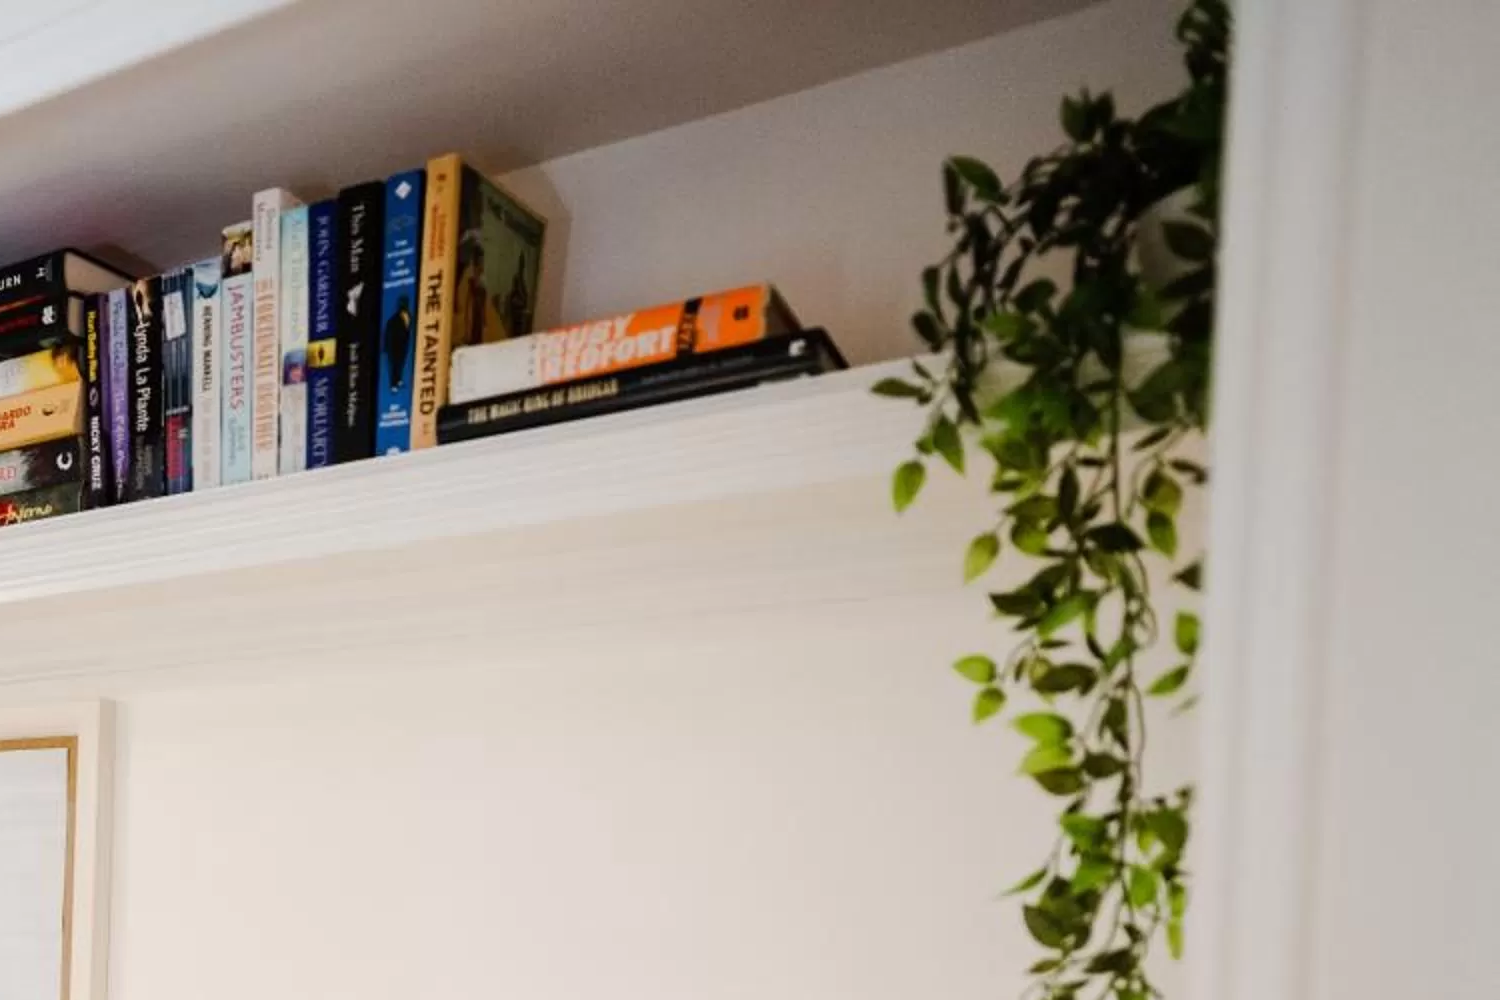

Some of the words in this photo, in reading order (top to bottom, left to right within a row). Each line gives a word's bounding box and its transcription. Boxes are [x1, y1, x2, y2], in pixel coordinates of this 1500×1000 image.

[350, 204, 366, 235] This
[350, 240, 364, 272] Man
[315, 260, 329, 333] GARDNER
[425, 270, 444, 313] THE
[134, 321, 153, 363] Lynda
[202, 305, 213, 347] HENNING
[227, 284, 246, 412] JAMBUSTERS
[420, 320, 442, 415] TAINTED
[136, 367, 152, 385] La
[136, 388, 152, 432] Plante
[312, 377, 329, 466] MORIARTY
[90, 416, 101, 452] NICKY
[91, 455, 101, 491] CRUZ
